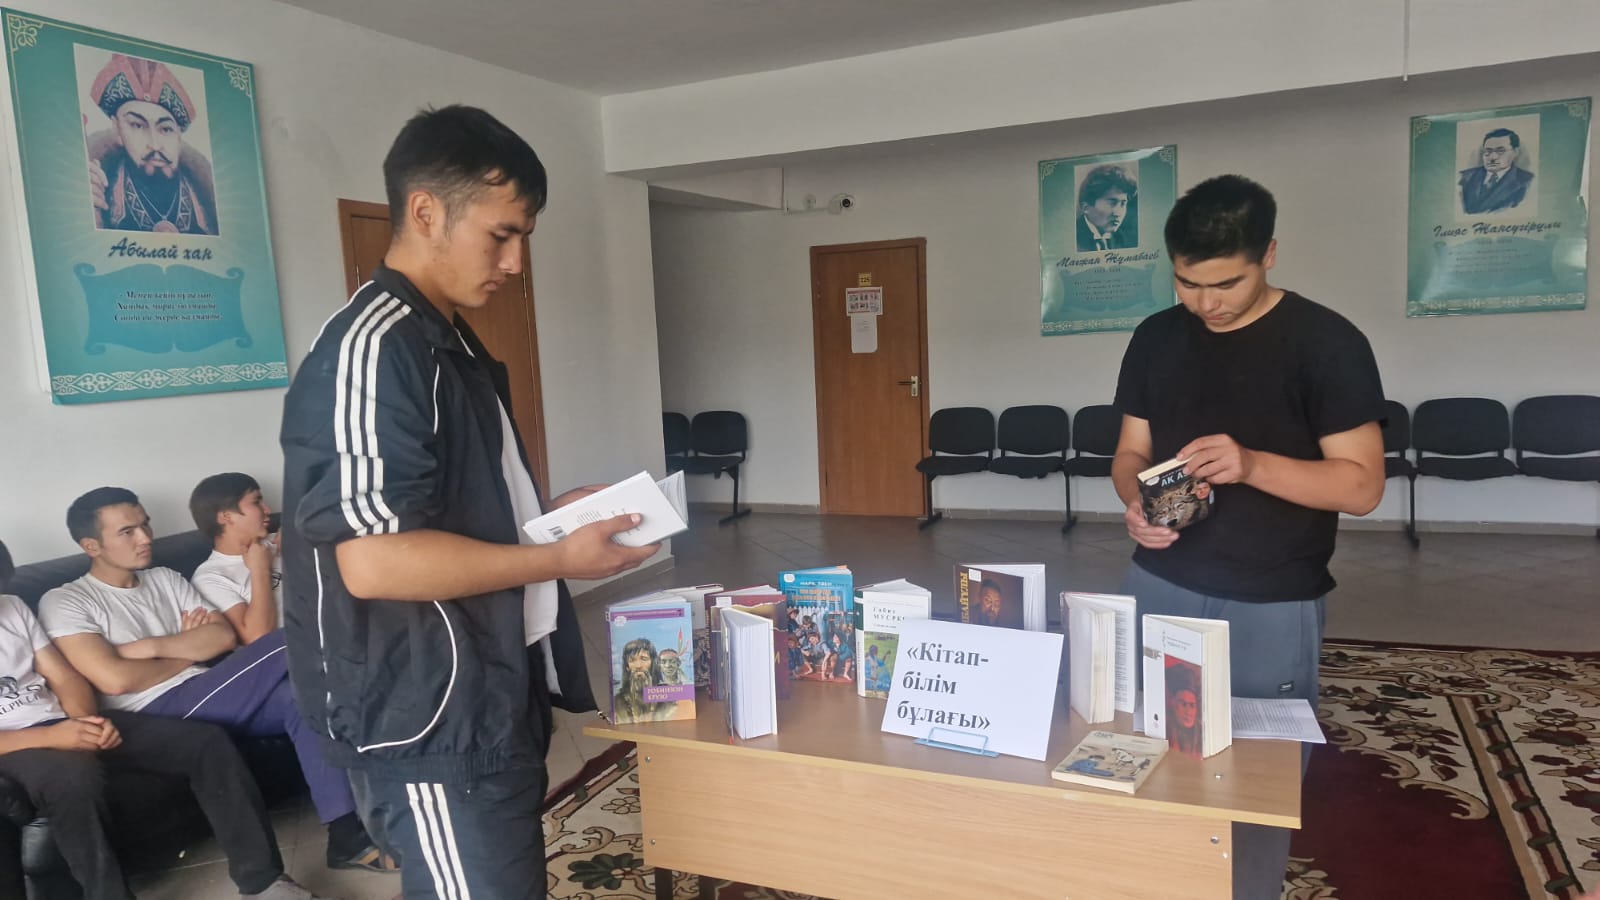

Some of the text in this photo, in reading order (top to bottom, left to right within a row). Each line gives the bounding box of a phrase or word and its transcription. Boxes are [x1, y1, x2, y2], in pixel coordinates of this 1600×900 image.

[108, 237, 213, 260] Абылай хан
[907, 642, 989, 667] «Кітап-
[902, 671, 957, 695] білім
[897, 700, 991, 730] бұлағы»
